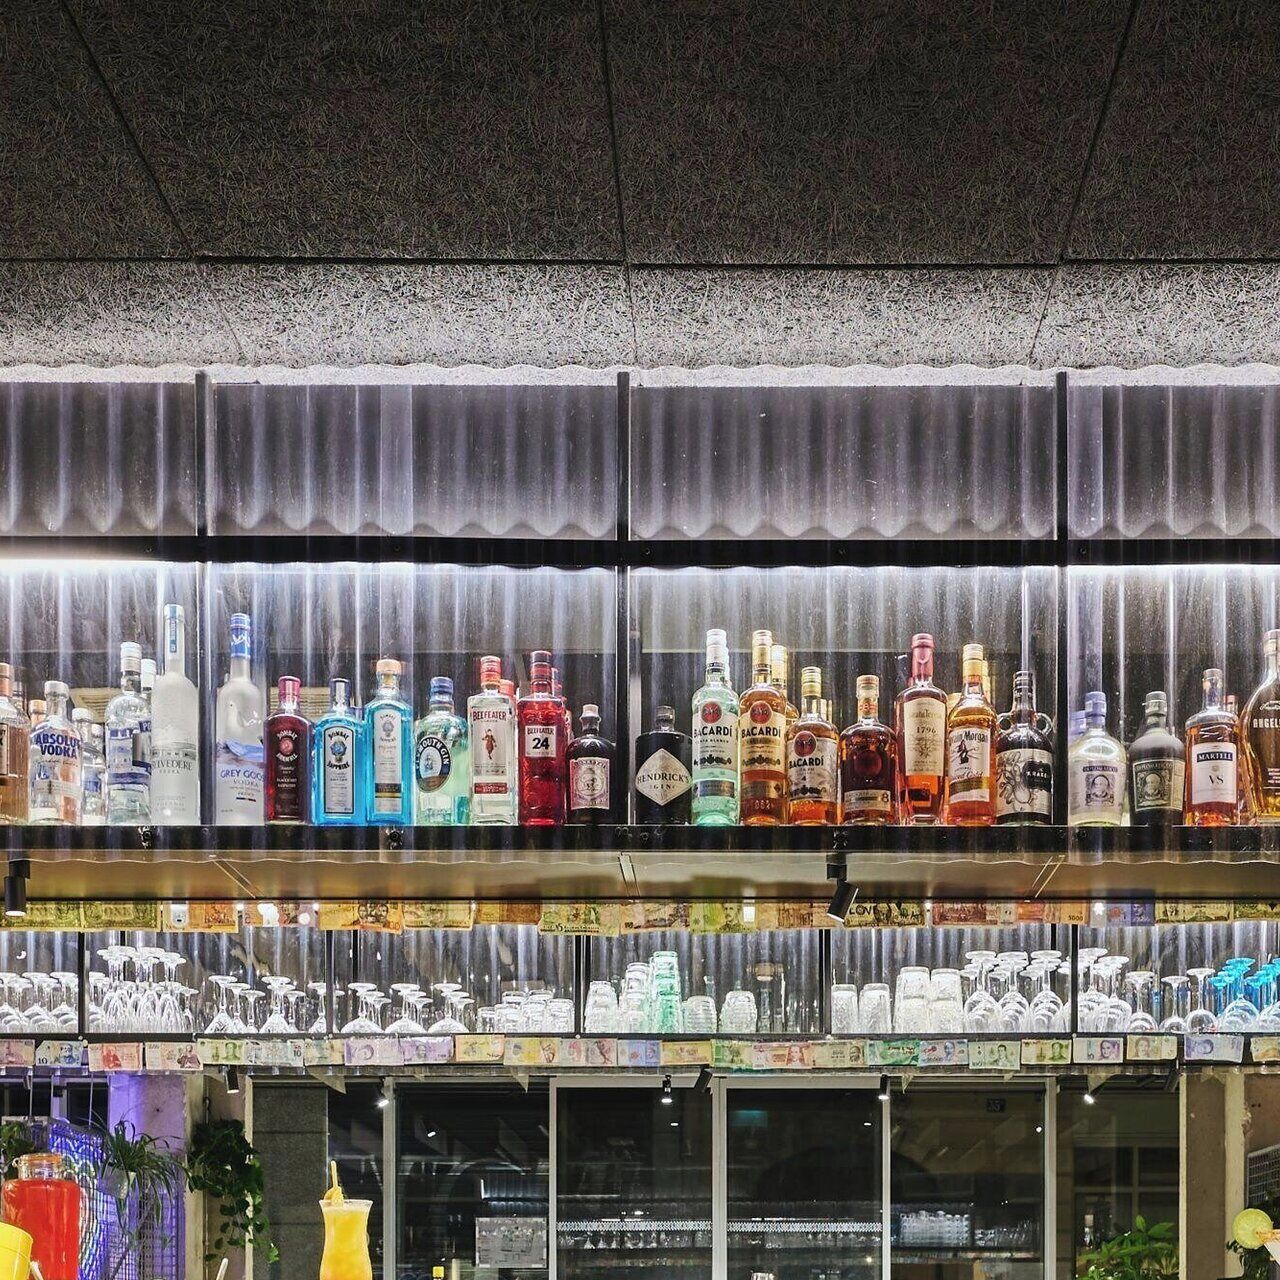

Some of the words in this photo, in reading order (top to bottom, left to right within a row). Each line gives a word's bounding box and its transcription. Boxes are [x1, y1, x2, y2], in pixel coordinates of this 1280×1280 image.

[473, 710, 507, 721] BEEFEATER
[527, 727, 554, 735] BEEFEATER
[694, 725, 732, 738] BACARDÍ
[741, 725, 781, 738] BACARDÍ
[35, 733, 81, 749] ABSOLUT
[533, 737, 549, 750] 24
[40, 745, 77, 759] VODKA
[1198, 752, 1232, 761] MARTELL
[789, 756, 824, 769] BACARDÍ
[221, 769, 240, 779] GREY
[637, 772, 690, 784] HENDRICK'S
